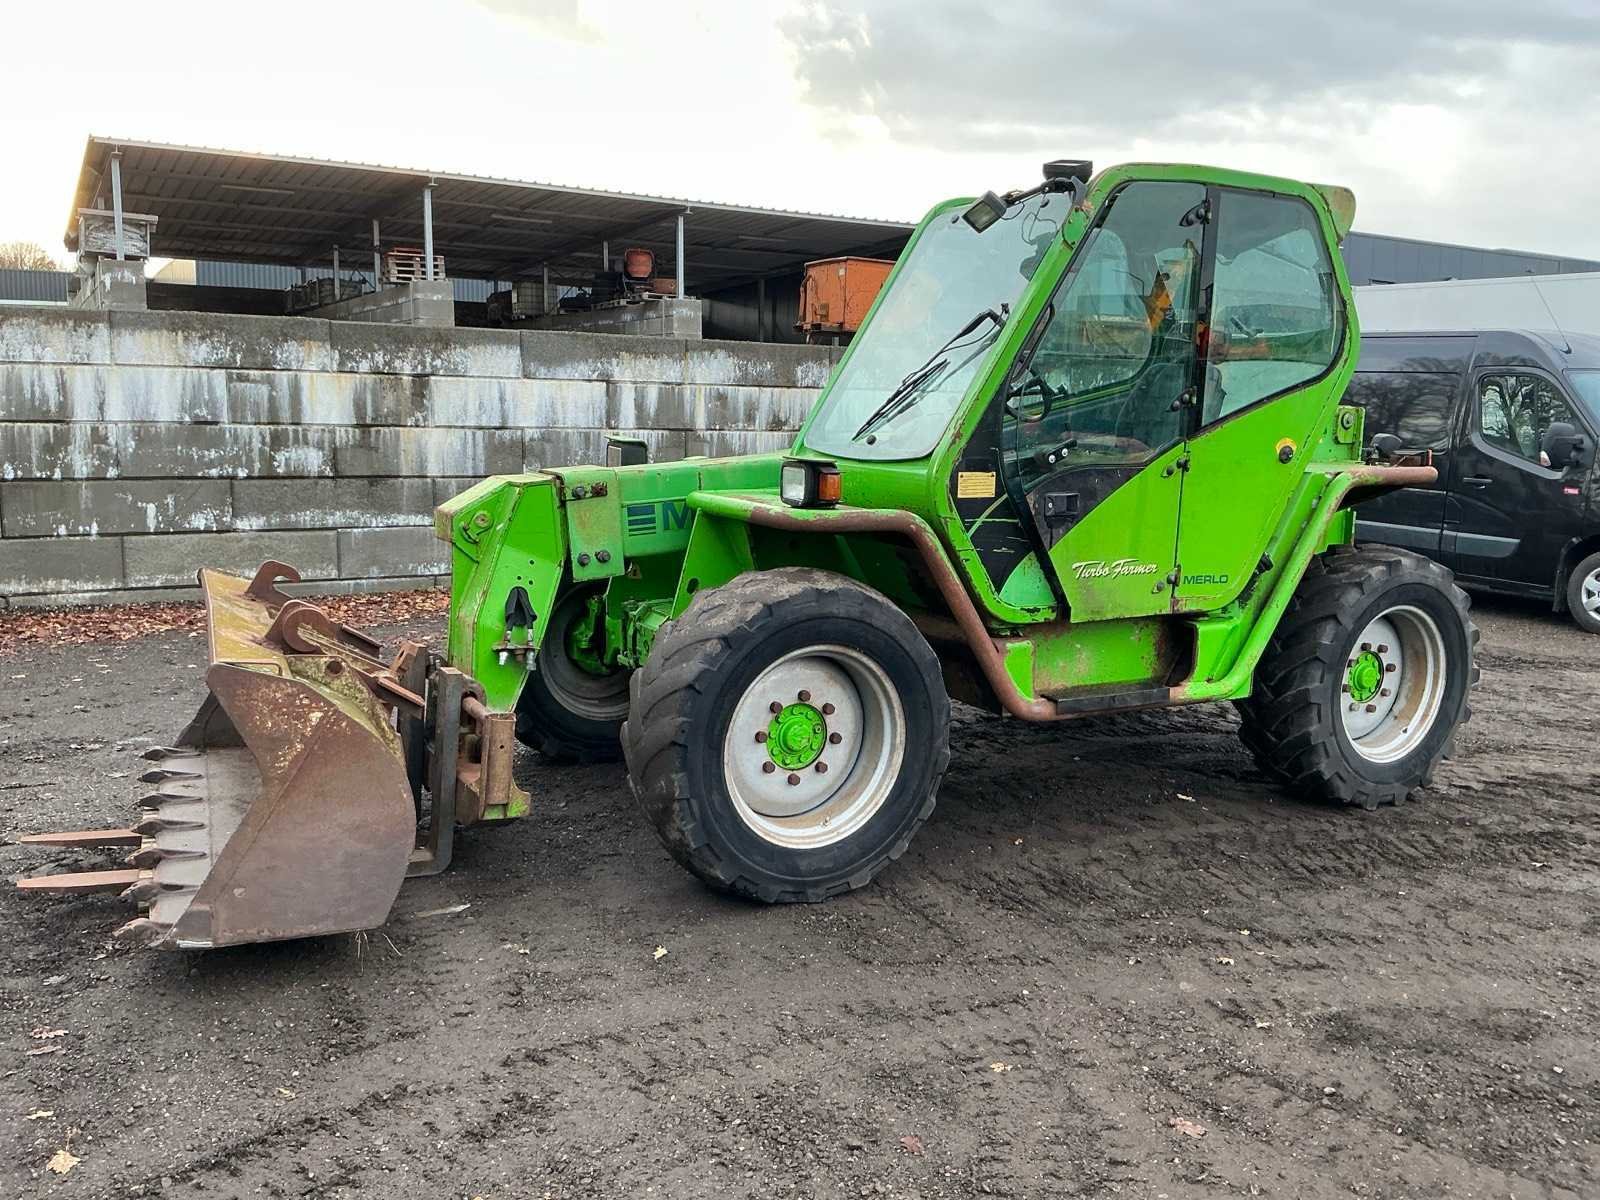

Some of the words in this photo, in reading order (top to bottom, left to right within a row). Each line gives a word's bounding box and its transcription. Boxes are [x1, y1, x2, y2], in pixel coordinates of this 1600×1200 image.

[1072, 560, 1110, 579] Turbo
[1111, 558, 1158, 579] Farmer
[1183, 574, 1229, 585] MERLO
